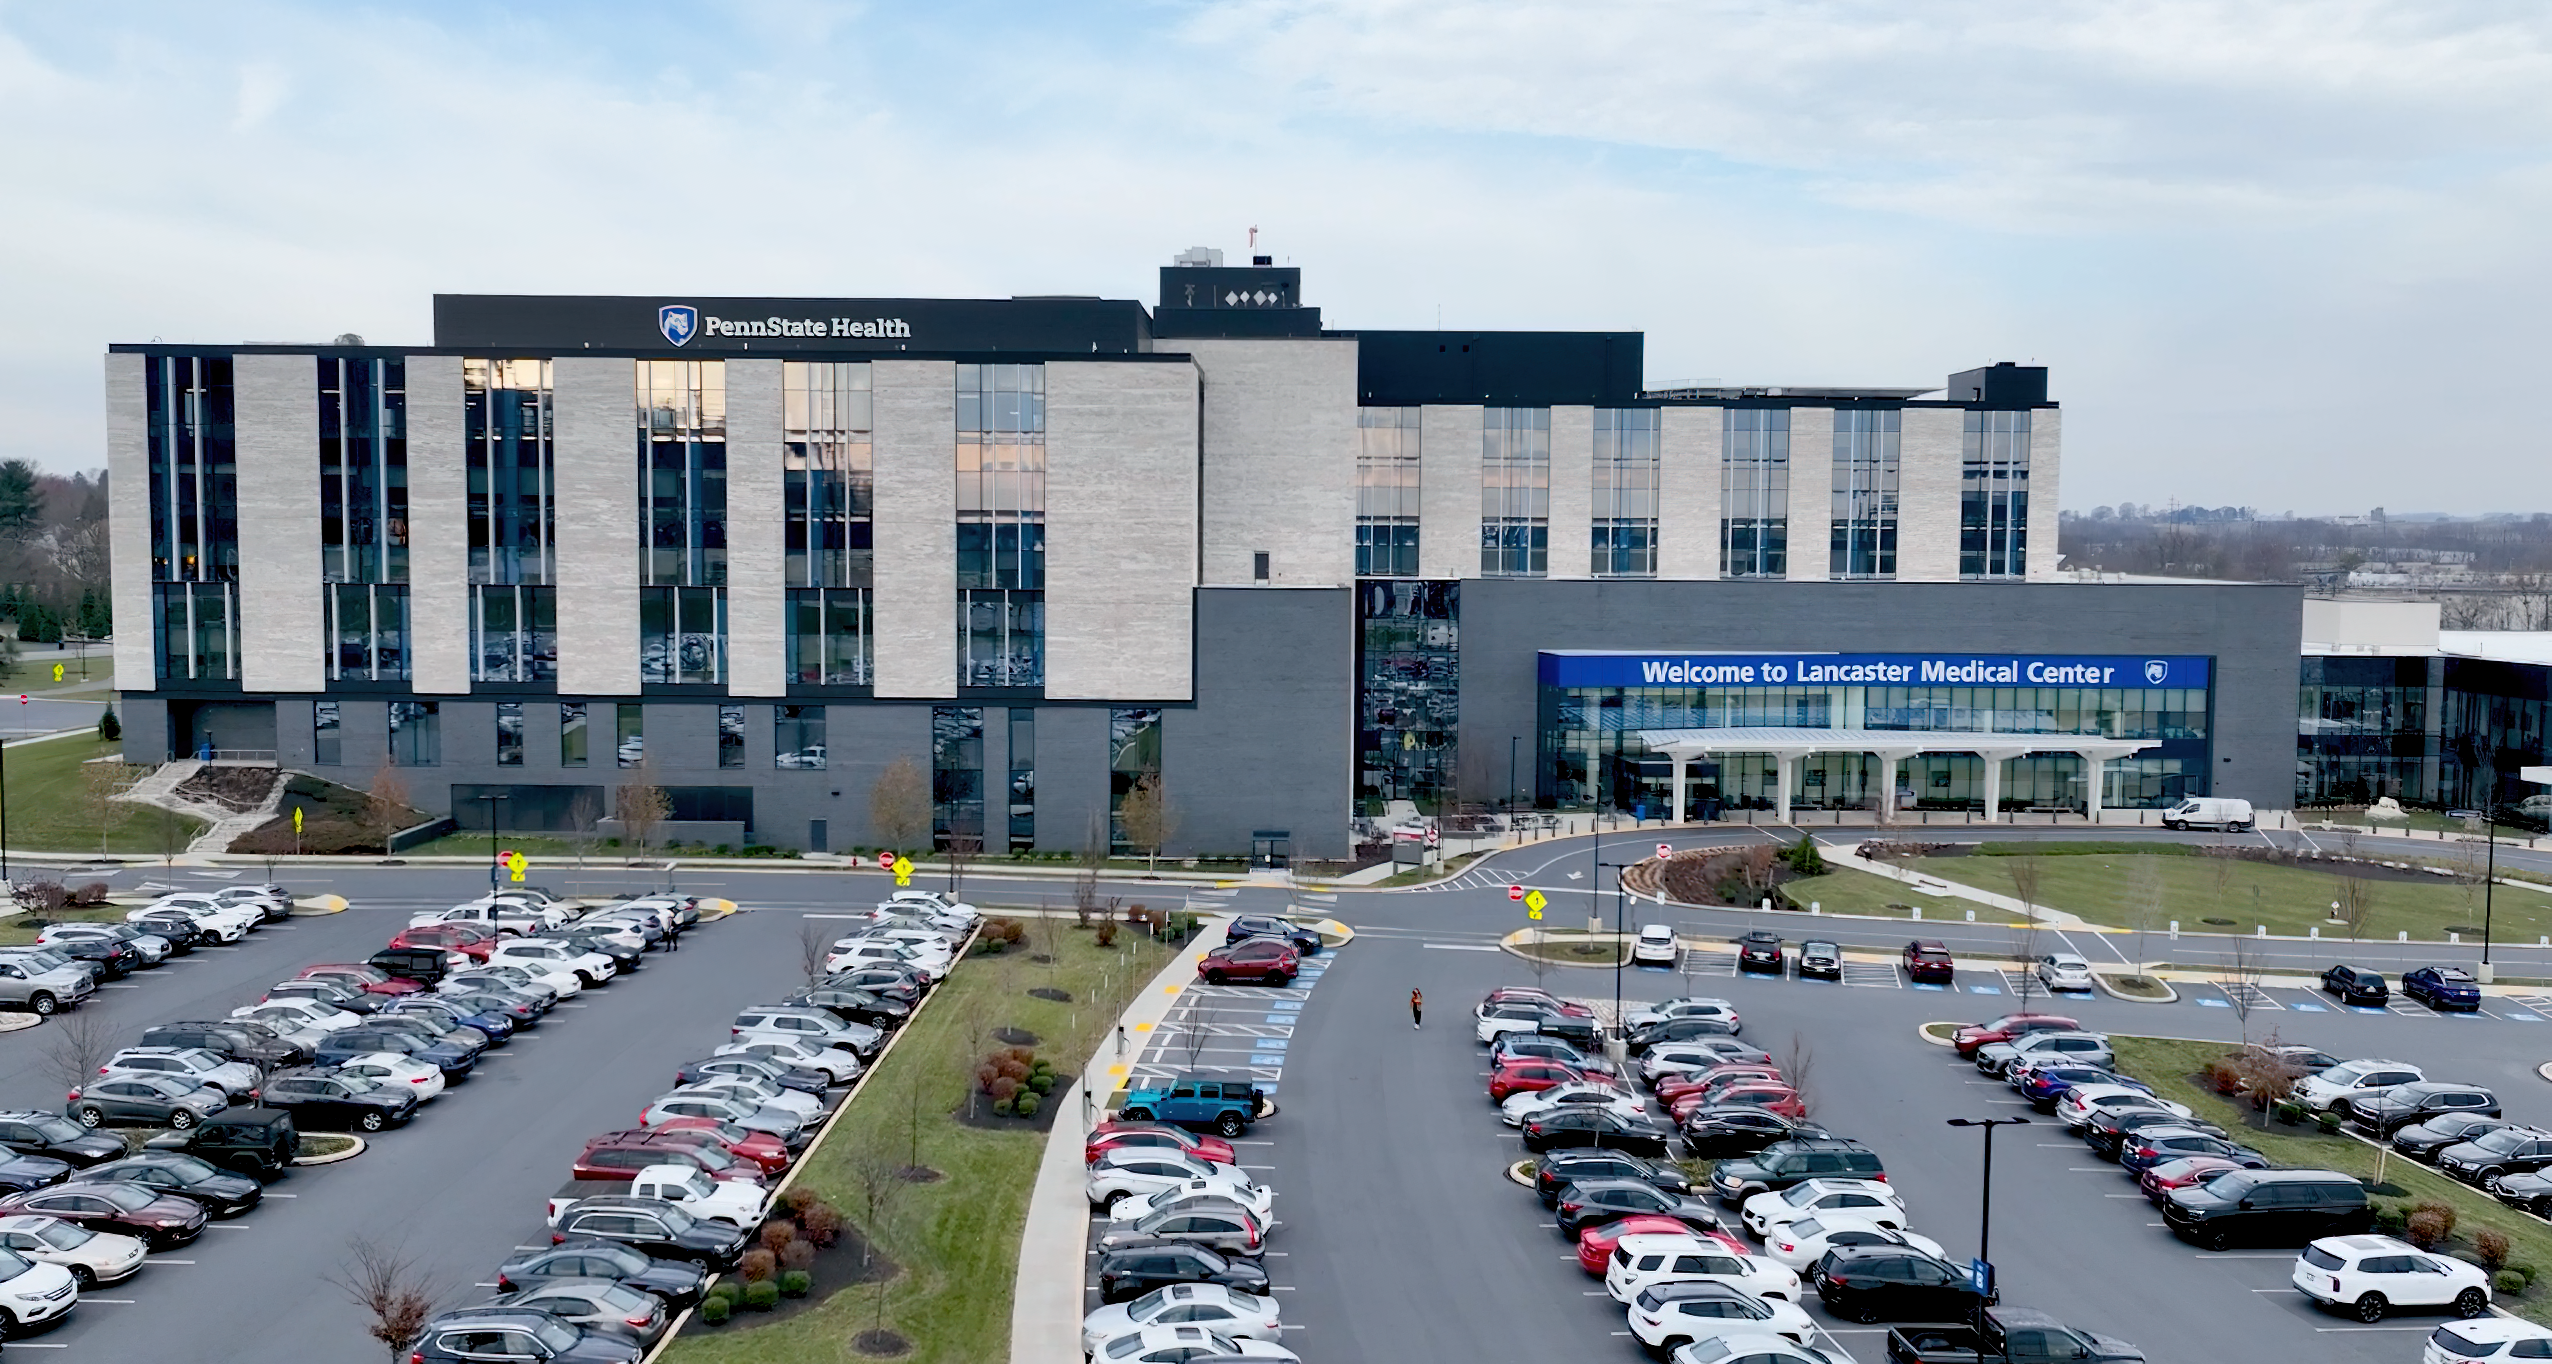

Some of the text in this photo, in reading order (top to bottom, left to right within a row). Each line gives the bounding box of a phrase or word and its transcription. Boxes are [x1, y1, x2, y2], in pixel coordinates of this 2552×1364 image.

[704, 316, 912, 338] PennState Health
[1642, 659, 2115, 684] Welcome to Lancaster Medical Center
